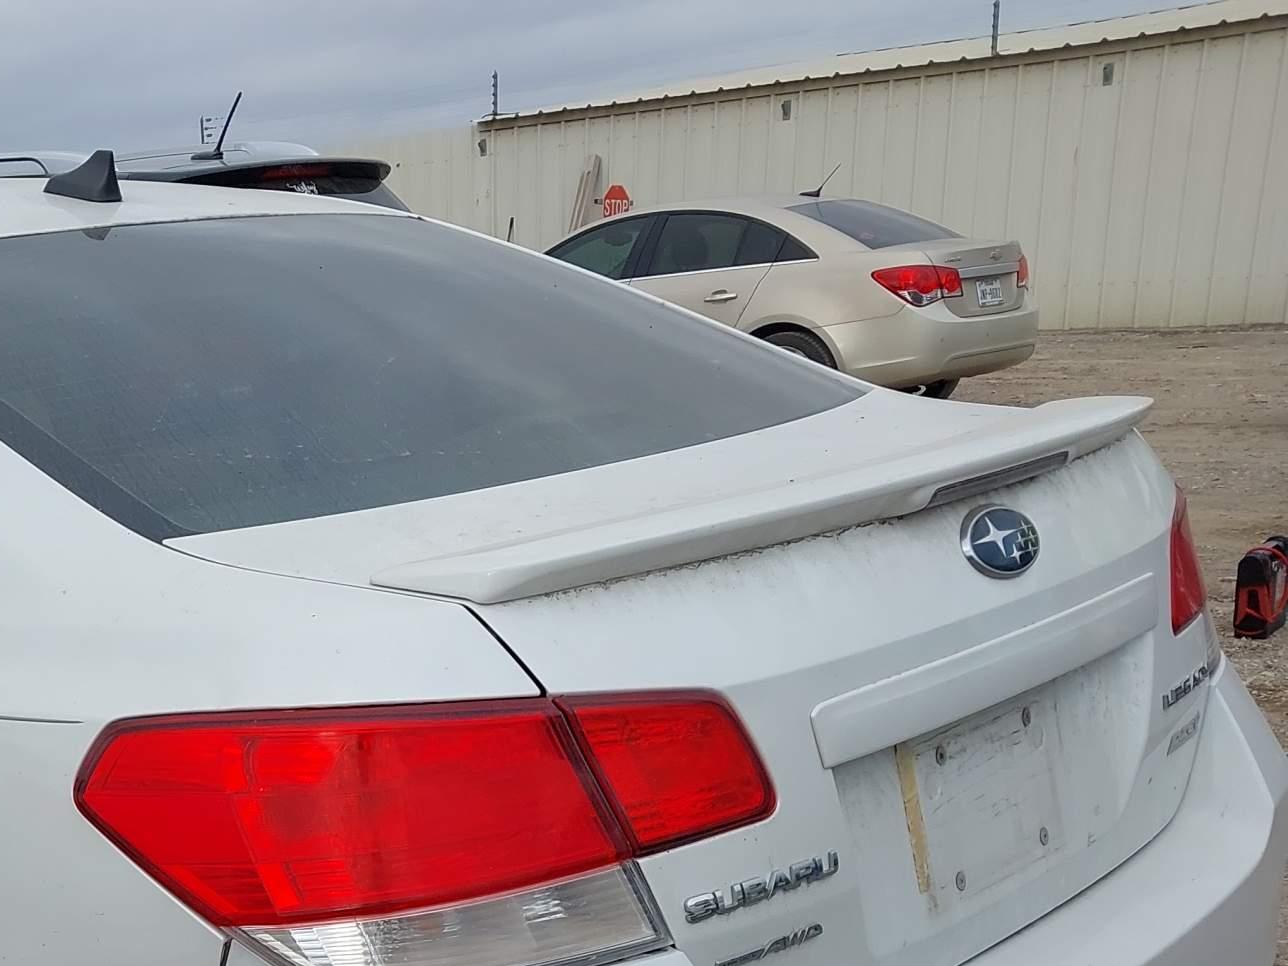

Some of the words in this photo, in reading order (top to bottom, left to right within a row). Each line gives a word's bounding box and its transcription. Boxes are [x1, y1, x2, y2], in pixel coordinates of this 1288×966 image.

[604, 199, 629, 216] STOP
[684, 850, 839, 924] SUBARU
[760, 922, 824, 959] AWD
